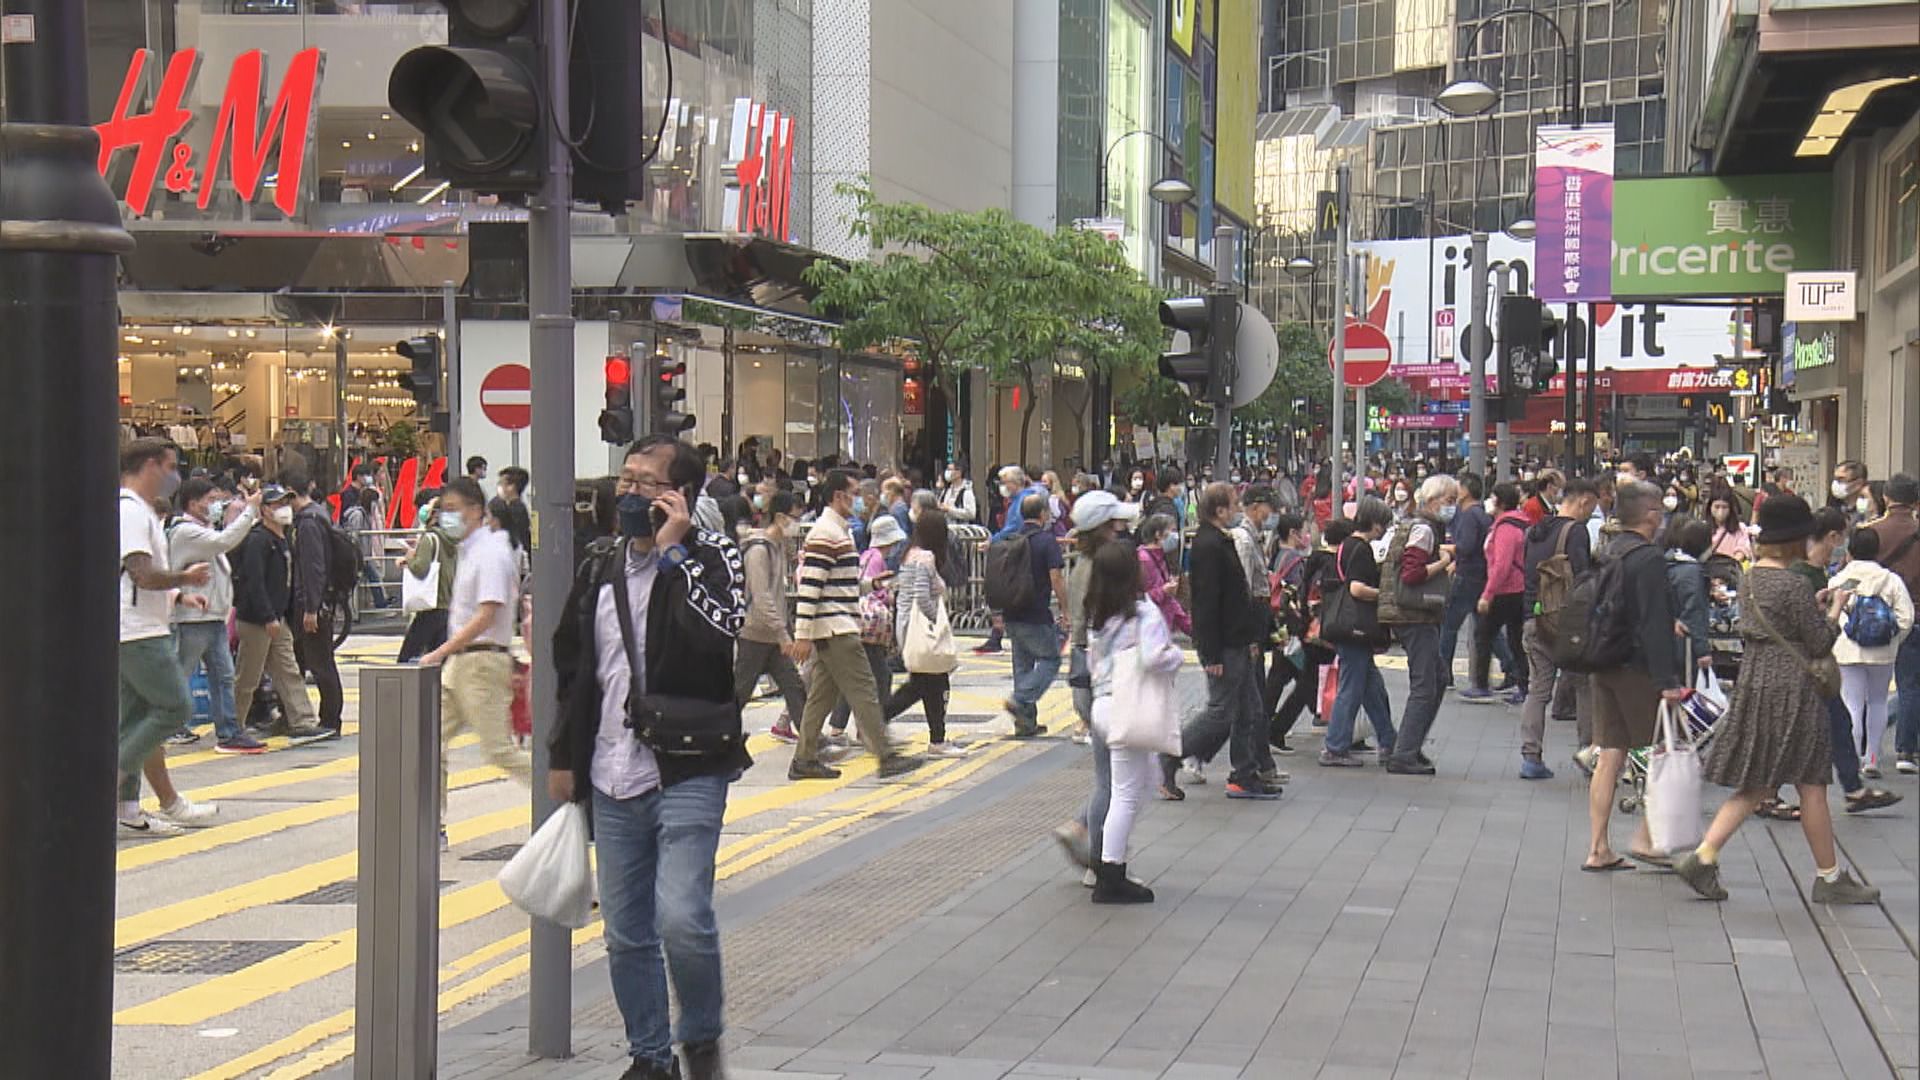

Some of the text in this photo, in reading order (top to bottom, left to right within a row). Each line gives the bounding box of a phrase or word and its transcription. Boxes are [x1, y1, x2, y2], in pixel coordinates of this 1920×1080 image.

[93, 46, 319, 217] H&M
[736, 97, 796, 243] H&M
[1706, 196, 1795, 236] 實惠
